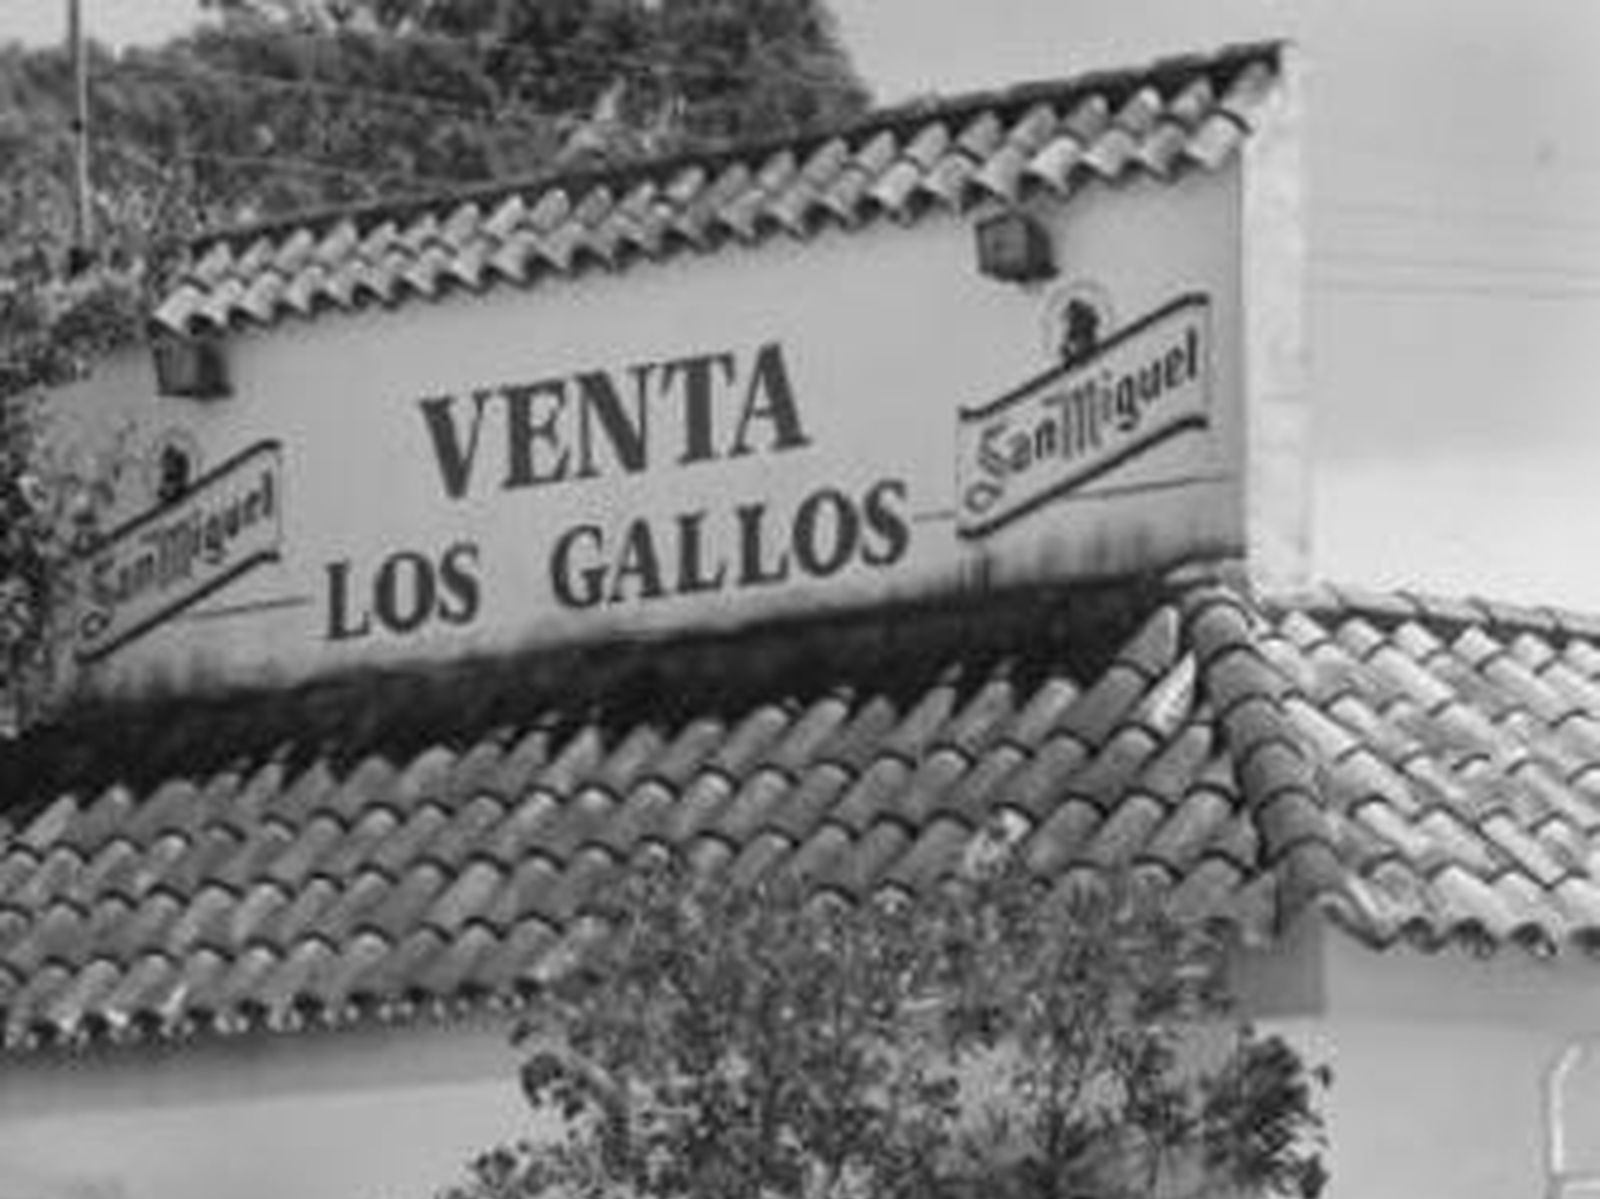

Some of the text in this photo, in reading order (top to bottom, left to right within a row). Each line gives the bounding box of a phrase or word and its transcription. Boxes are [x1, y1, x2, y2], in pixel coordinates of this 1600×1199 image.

[419, 342, 809, 498] VENTA
[325, 478, 908, 641] LOS GALLOS
